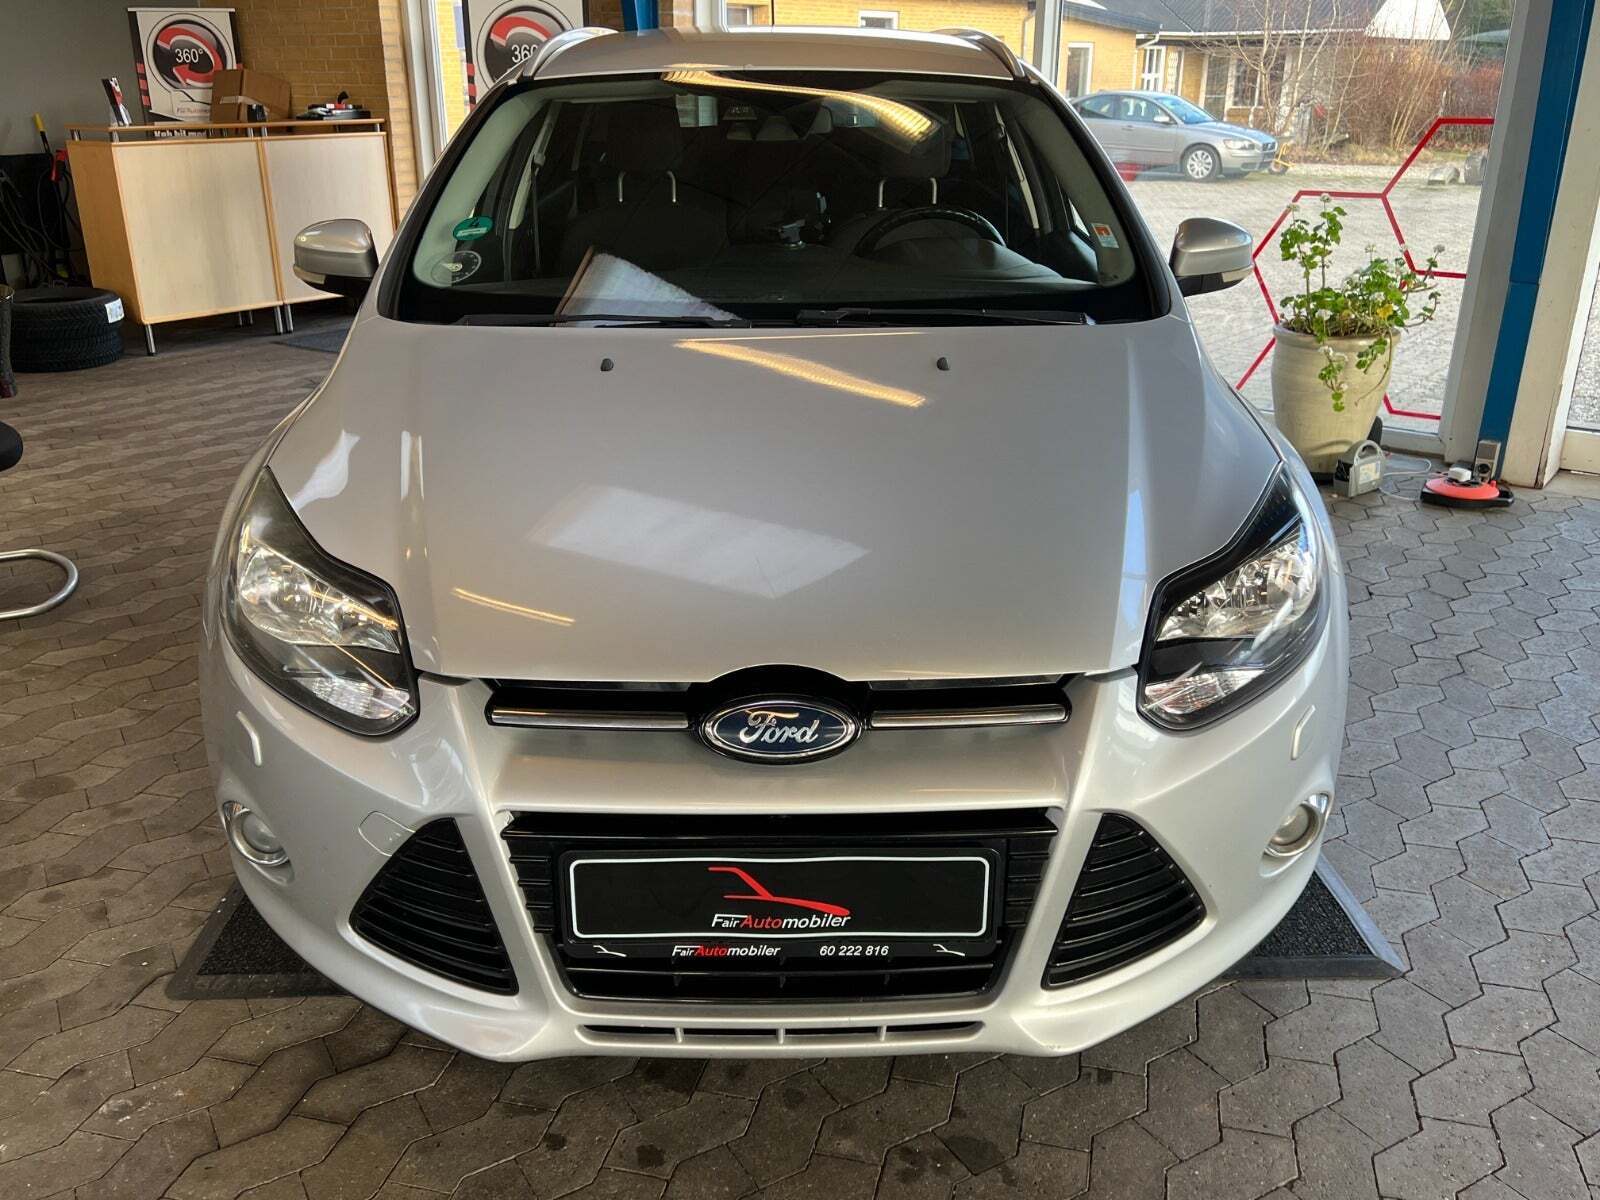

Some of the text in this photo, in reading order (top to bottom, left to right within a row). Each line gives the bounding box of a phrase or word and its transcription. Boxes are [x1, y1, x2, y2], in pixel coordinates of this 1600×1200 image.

[175, 48, 204, 63] 360°
[739, 708, 820, 744] Ford
[711, 913, 851, 929] FairAutomobiler
[672, 945, 781, 957] FairAutomobiler
[819, 945, 889, 956] 60 222 816
